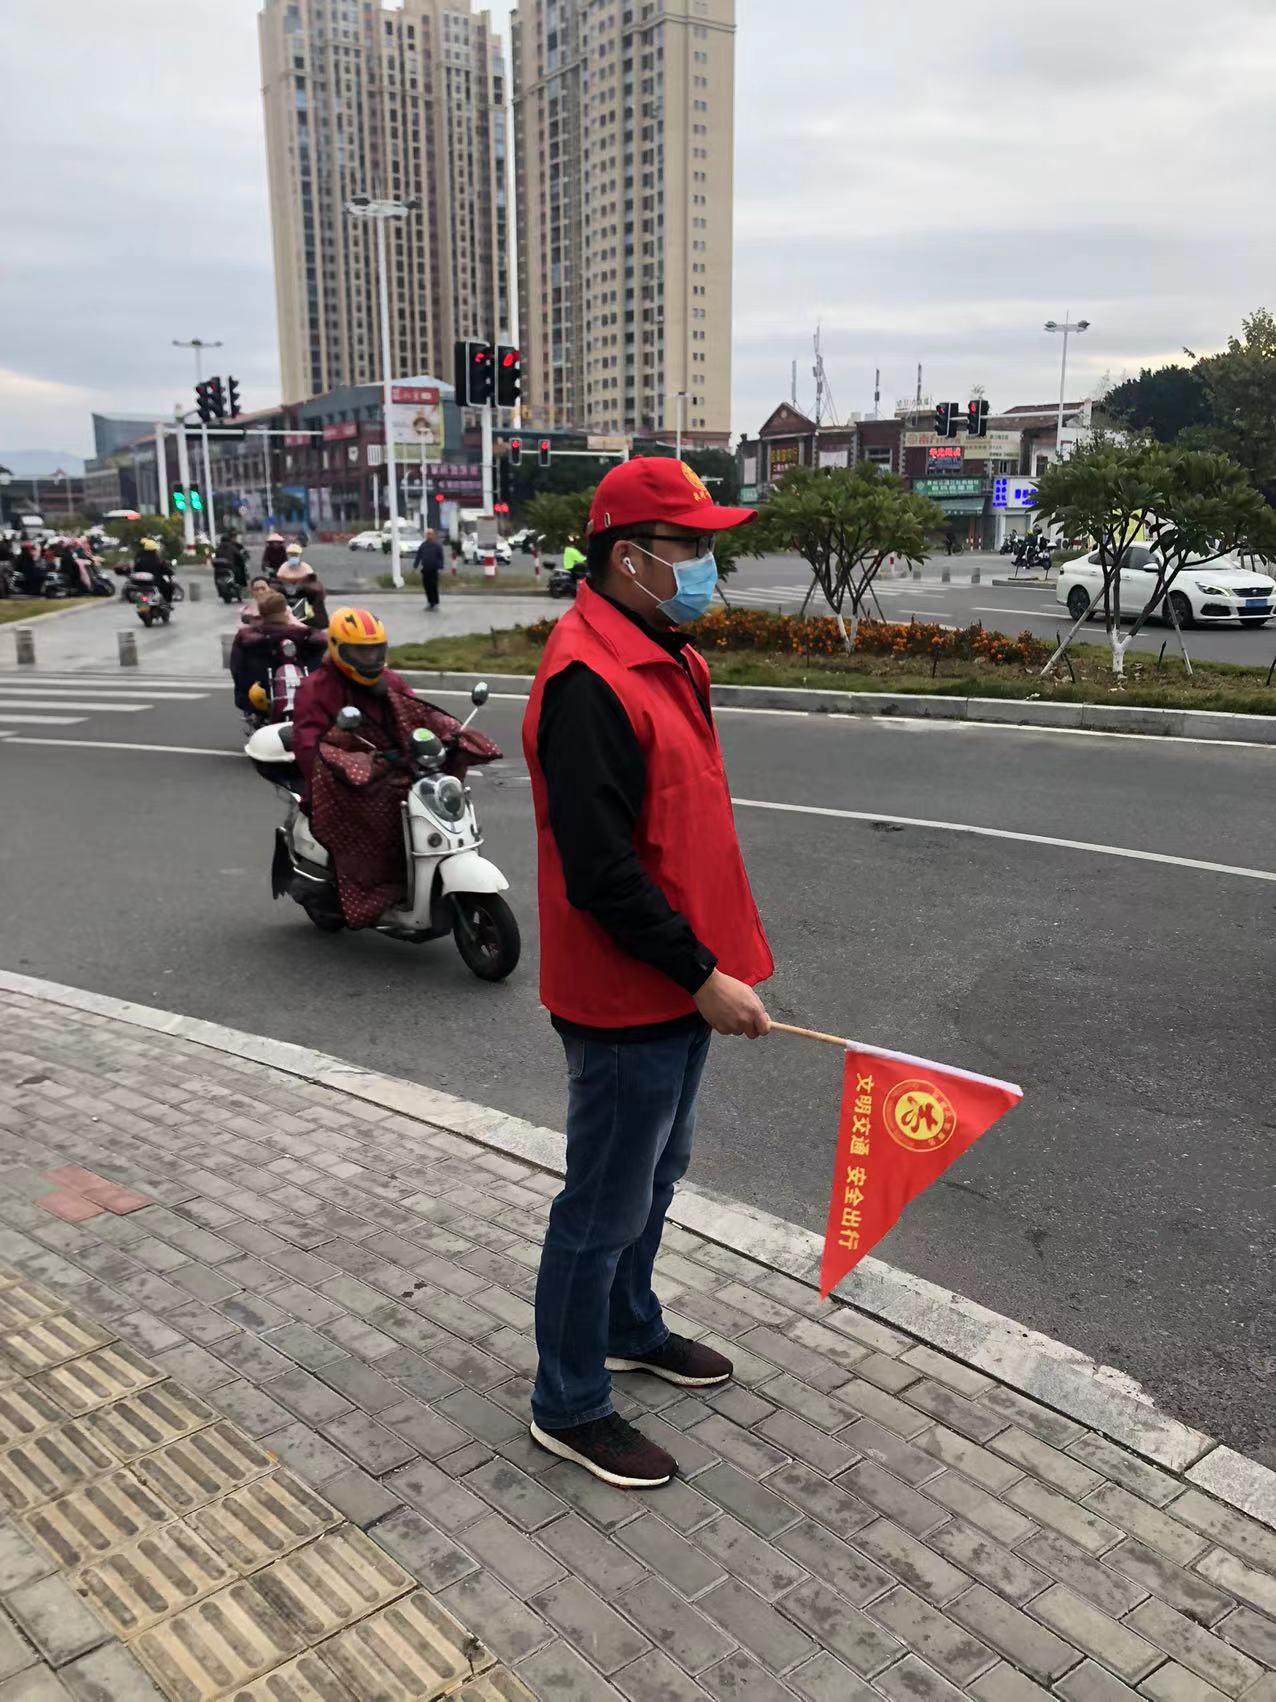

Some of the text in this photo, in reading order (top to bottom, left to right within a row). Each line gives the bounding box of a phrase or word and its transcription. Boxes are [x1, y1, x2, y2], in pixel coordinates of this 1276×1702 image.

[838, 1073, 875, 1249] 文明交通 安全出行
